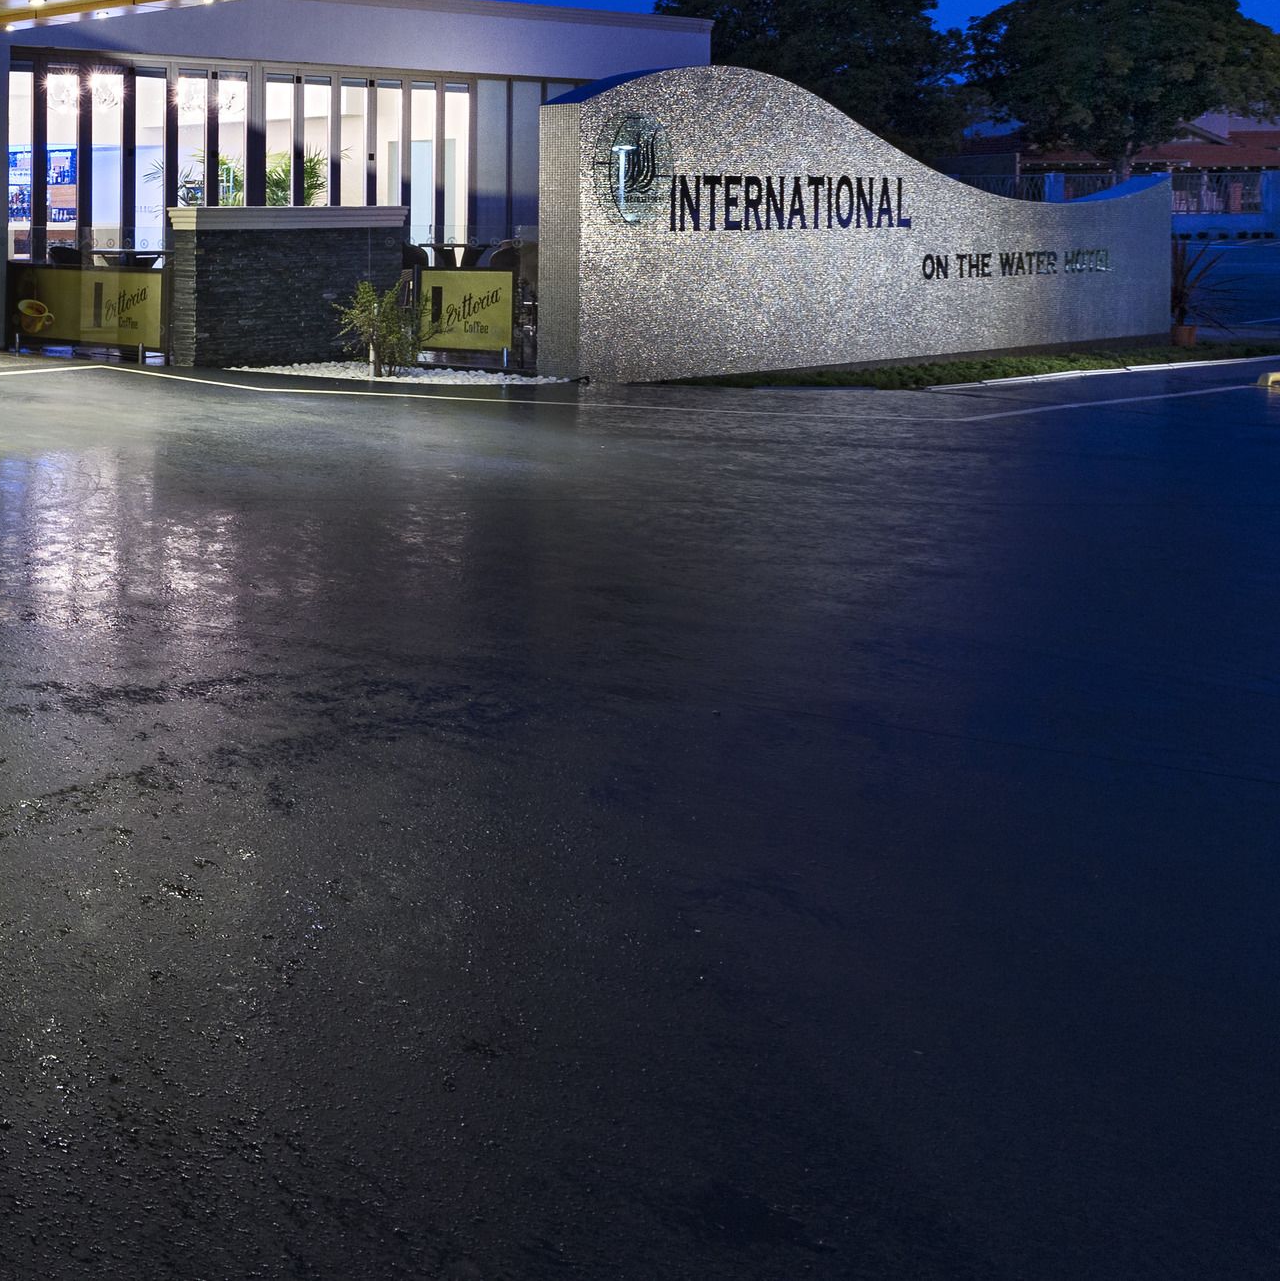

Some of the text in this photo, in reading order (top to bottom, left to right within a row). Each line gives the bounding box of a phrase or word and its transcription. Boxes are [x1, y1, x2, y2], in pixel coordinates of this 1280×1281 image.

[670, 175, 912, 232] INTERNATIONAL
[922, 249, 1114, 280] ON THE WATER HOTEL
[446, 288, 501, 327] Vittoria
[464, 320, 489, 334] Coffee
